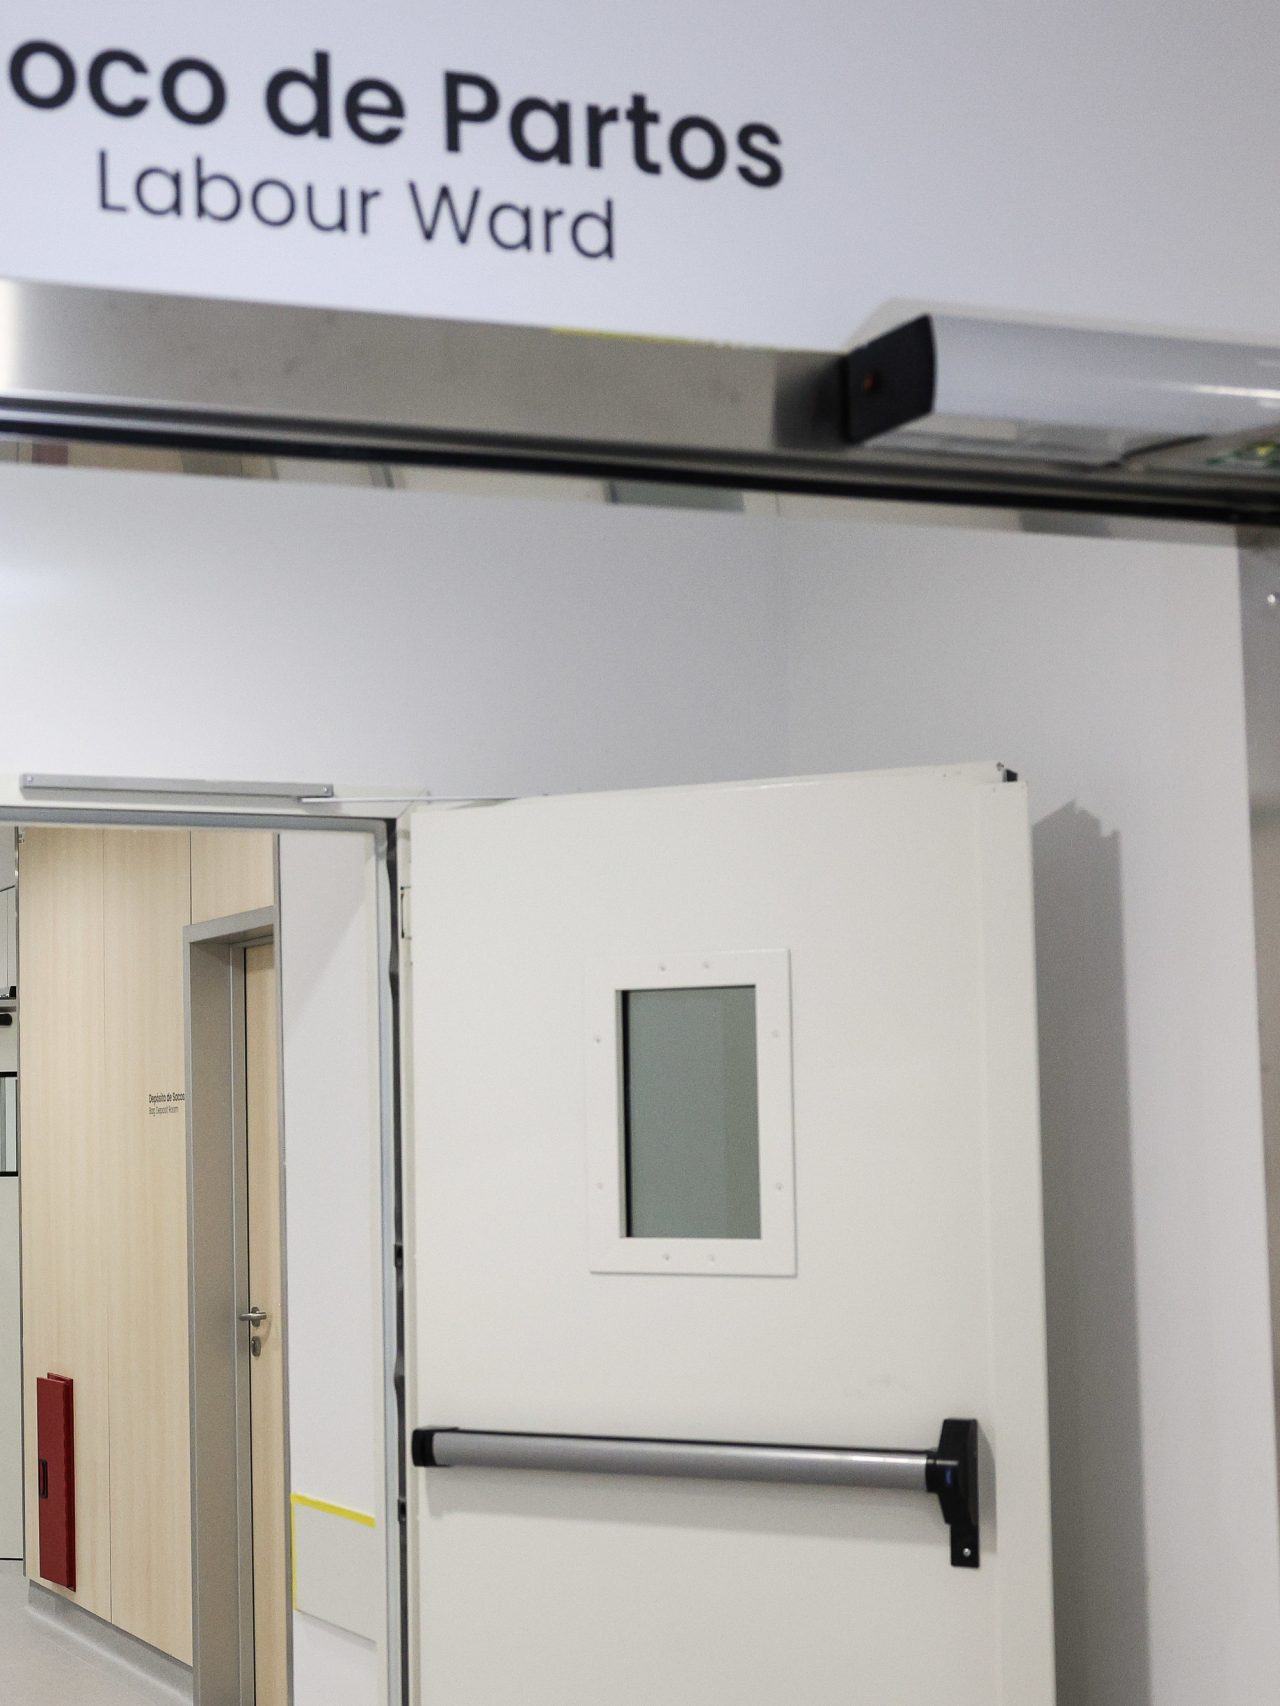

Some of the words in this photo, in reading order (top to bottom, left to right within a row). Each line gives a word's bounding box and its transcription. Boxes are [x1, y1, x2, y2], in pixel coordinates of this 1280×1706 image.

[265, 50, 406, 146] de
[444, 70, 783, 189] Partos
[99, 150, 380, 234] Labour
[408, 182, 614, 259] Ward
